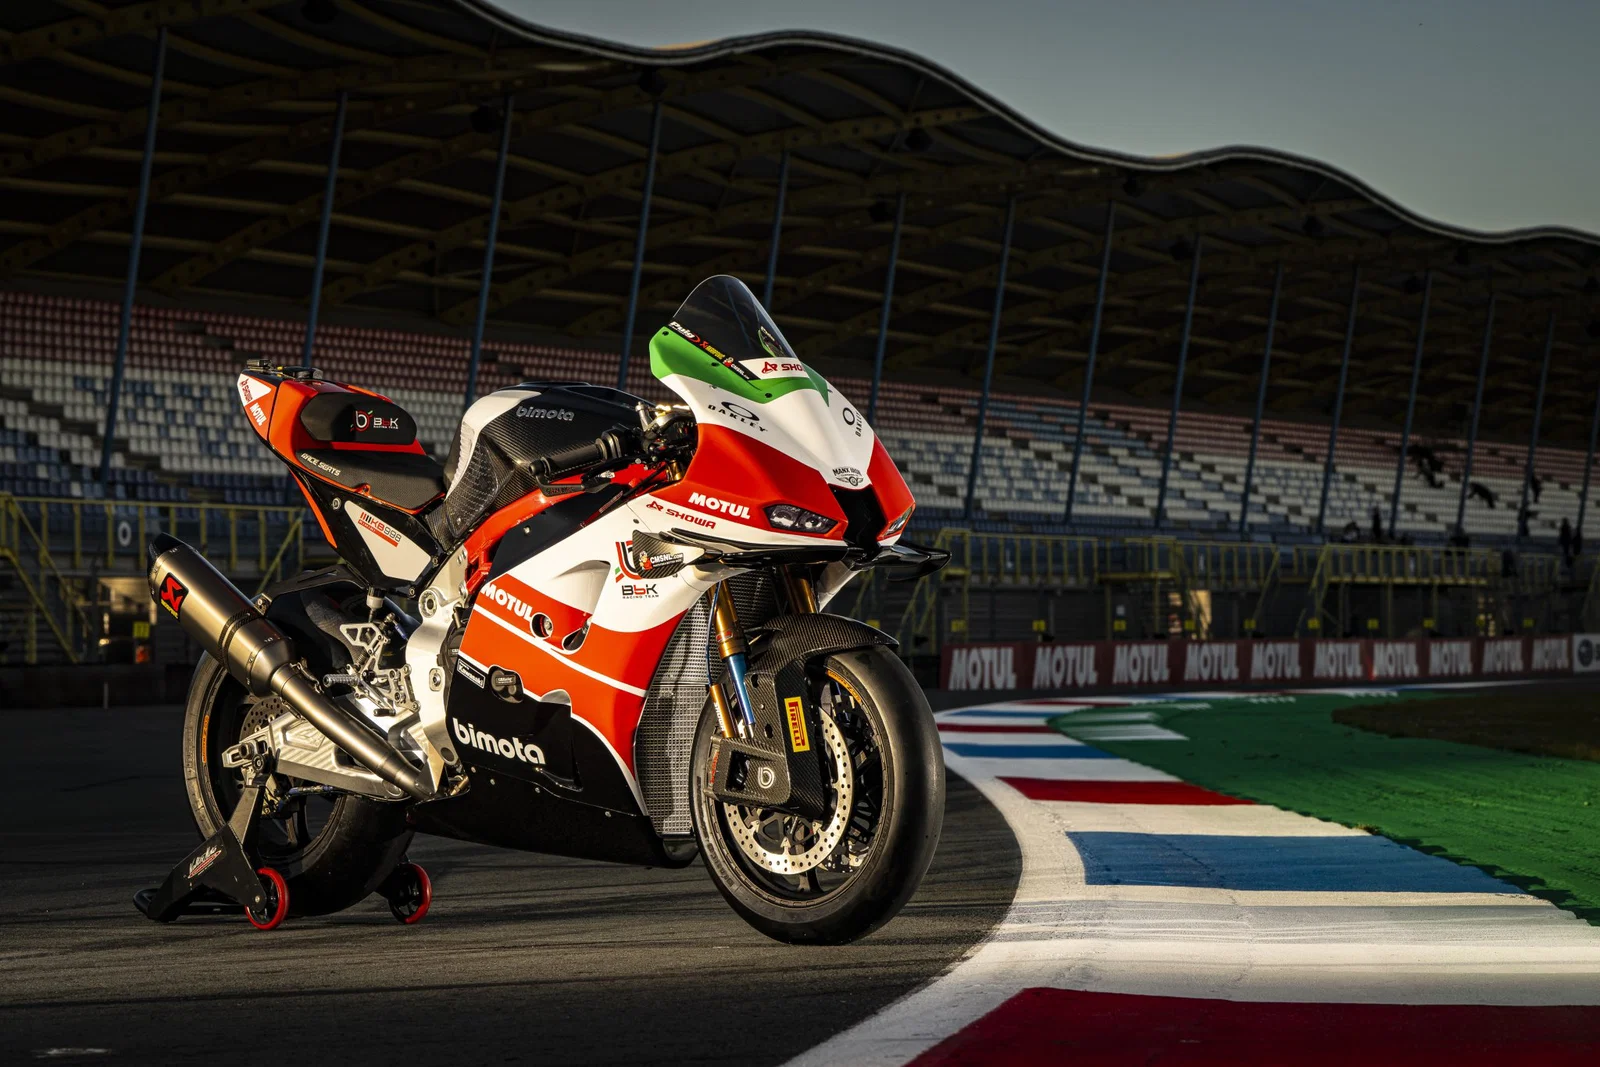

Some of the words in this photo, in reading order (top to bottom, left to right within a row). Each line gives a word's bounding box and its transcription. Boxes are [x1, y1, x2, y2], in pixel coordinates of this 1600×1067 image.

[668, 321, 696, 339] Puig
[781, 363, 804, 372] SHO
[250, 402, 267, 426] MOTUL
[516, 406, 575, 421] bimota
[708, 404, 768, 432] OAKLEY
[301, 453, 320, 466] RACE
[318, 462, 341, 477] SEATS
[666, 508, 717, 529] SHOWA
[688, 492, 751, 520] MOTUL
[480, 583, 533, 622] MOTUL
[949, 647, 1017, 690] MOTUL
[1033, 645, 1098, 689] MOTUL
[1113, 644, 1169, 684] MOTUL
[1184, 642, 1239, 680] MOTUL
[1251, 642, 1301, 679] MOTUL
[1313, 642, 1363, 679] MOTUL
[1373, 643, 1420, 678] MOTUL
[452, 717, 546, 765] bimota
[788, 701, 806, 747] PIRELLI
